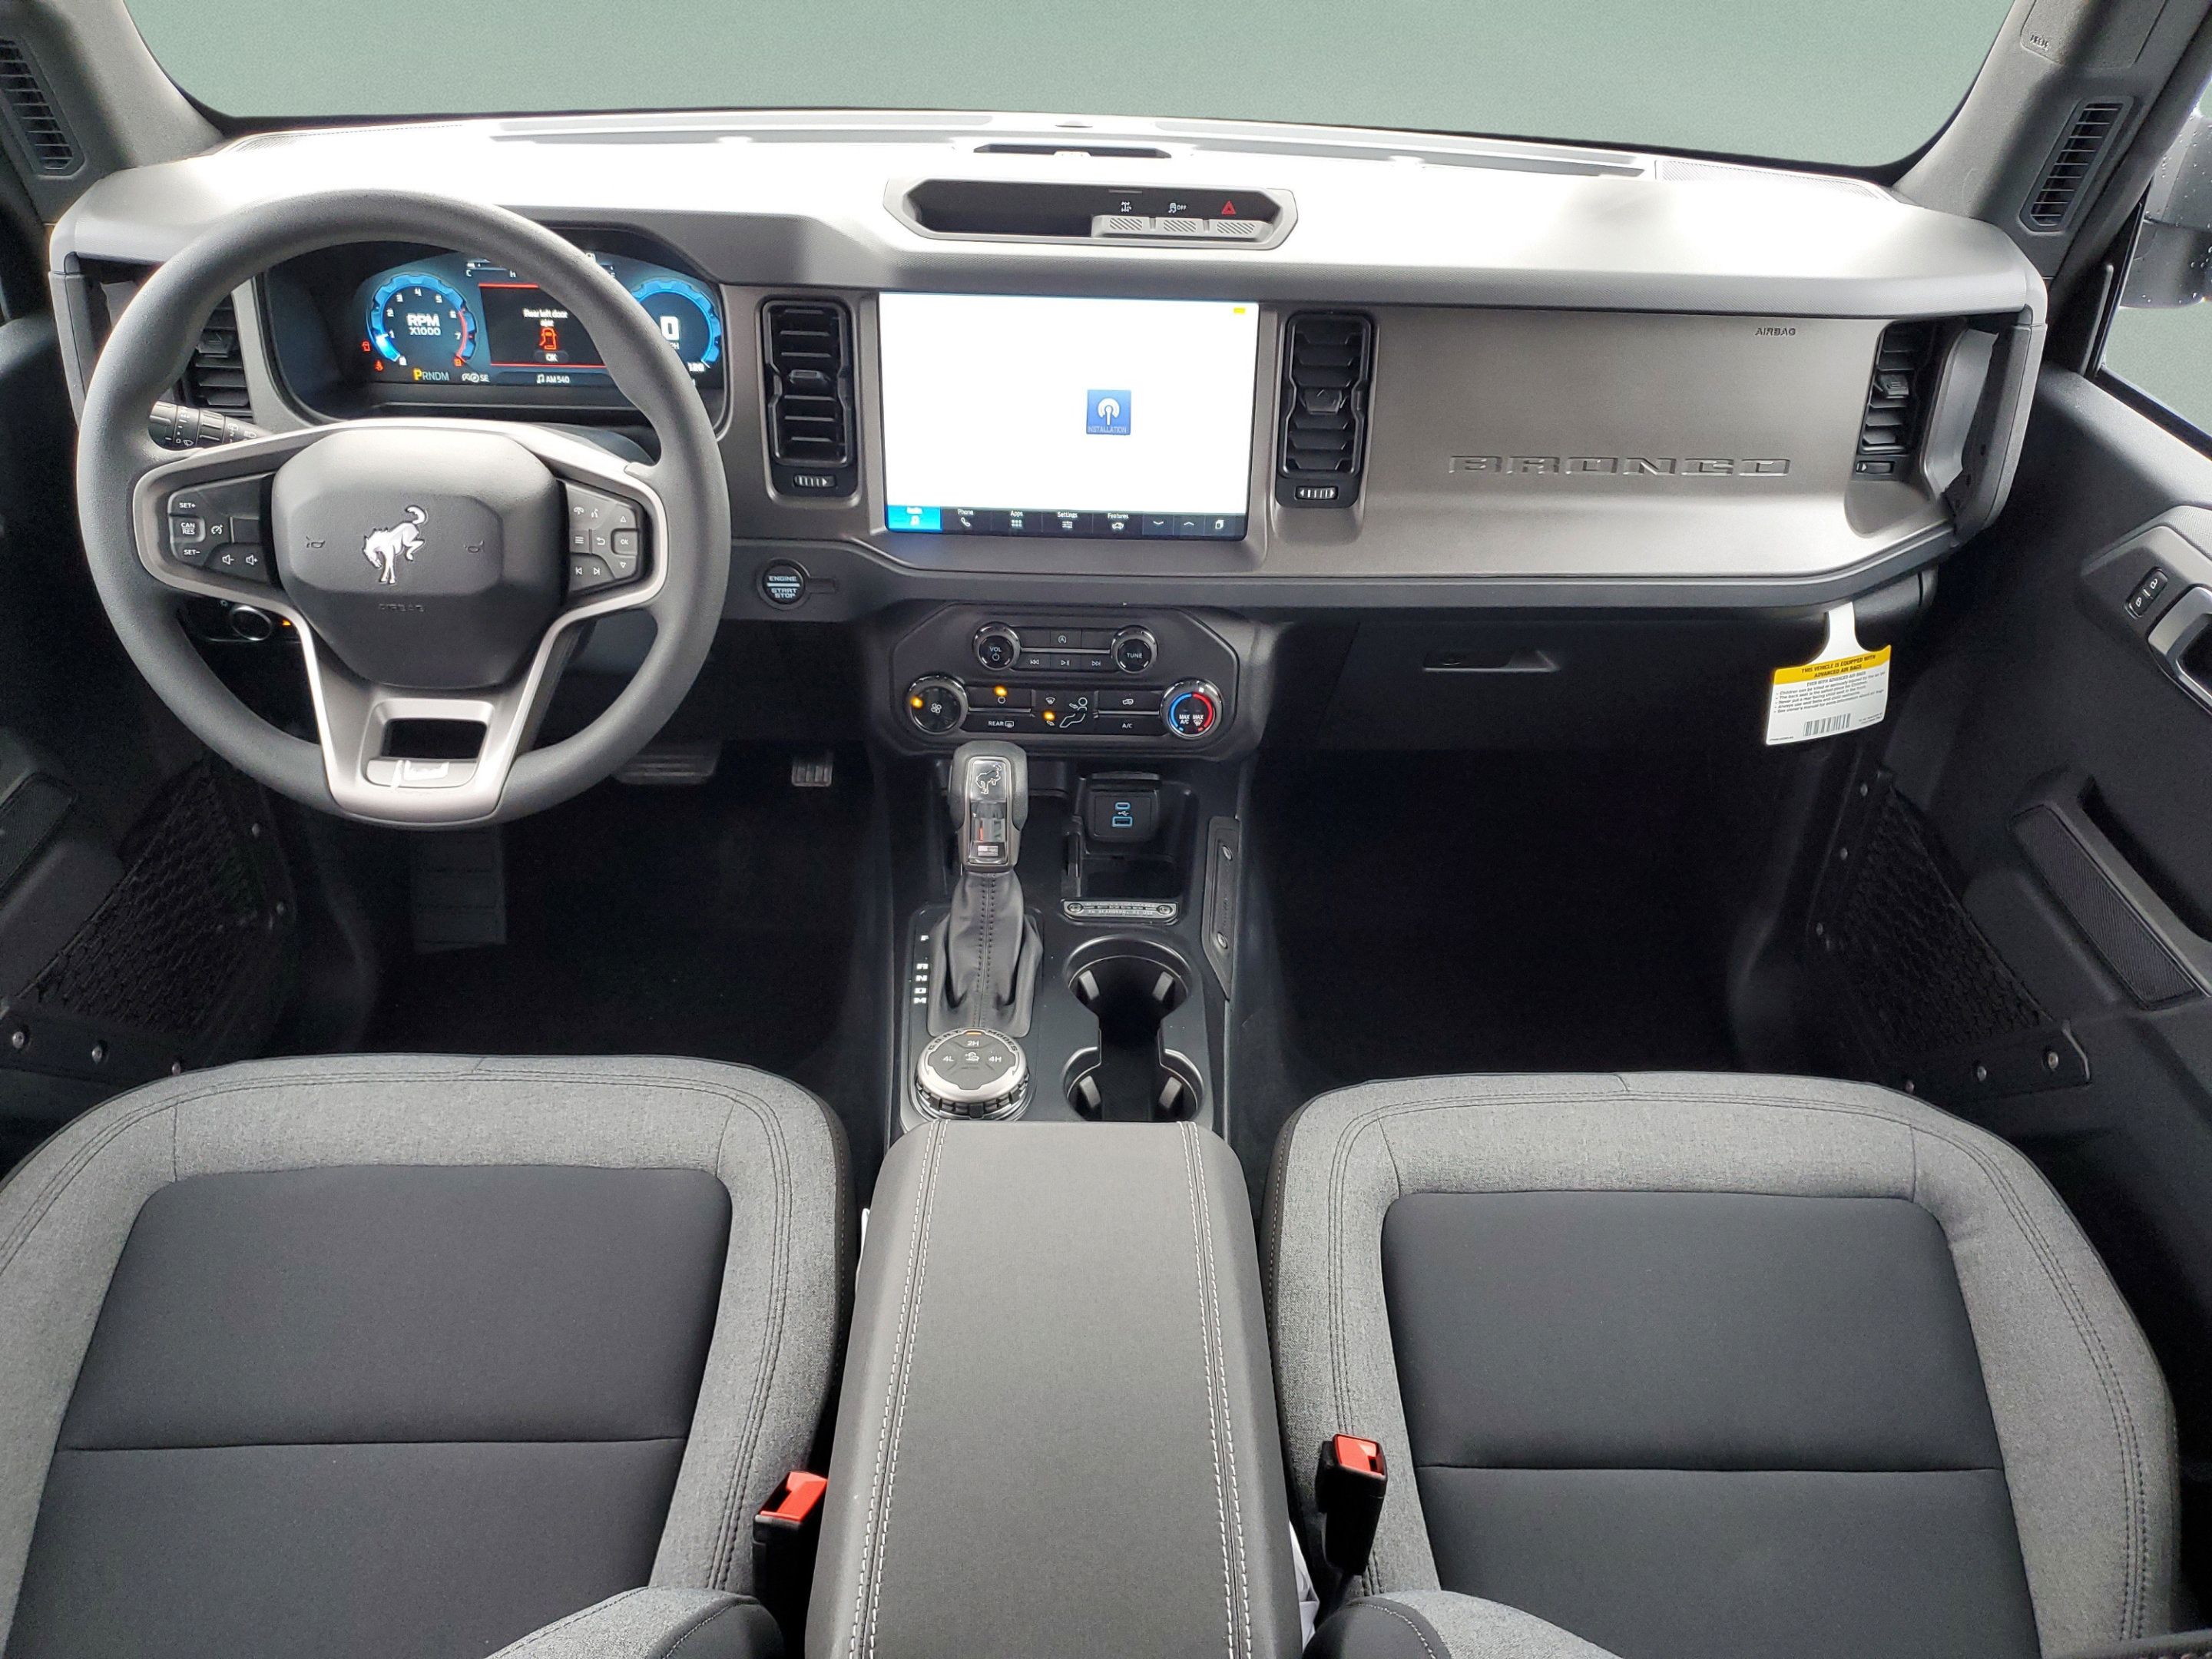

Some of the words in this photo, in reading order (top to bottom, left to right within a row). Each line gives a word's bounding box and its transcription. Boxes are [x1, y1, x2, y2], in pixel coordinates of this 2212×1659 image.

[415, 288, 422, 296] 4
[396, 293, 403, 303] 3
[435, 294, 442, 303] 5
[386, 308, 394, 316] 2
[406, 313, 440, 326] RPM
[409, 326, 441, 336] X1000
[660, 316, 679, 340] 0
[1754, 327, 1796, 336] AIRBAG
[389, 330, 395, 339] 1
[455, 331, 461, 339] 7
[545, 353, 558, 362] OK
[546, 375, 557, 383] AM
[1088, 426, 1127, 434] INSTALLATION
[1448, 455, 1791, 476] BRONCO
[1840, 657, 1863, 667] EQUIPPED
[1814, 669, 1839, 677] ADVANCED
[988, 1030, 1018, 1051] MODES
